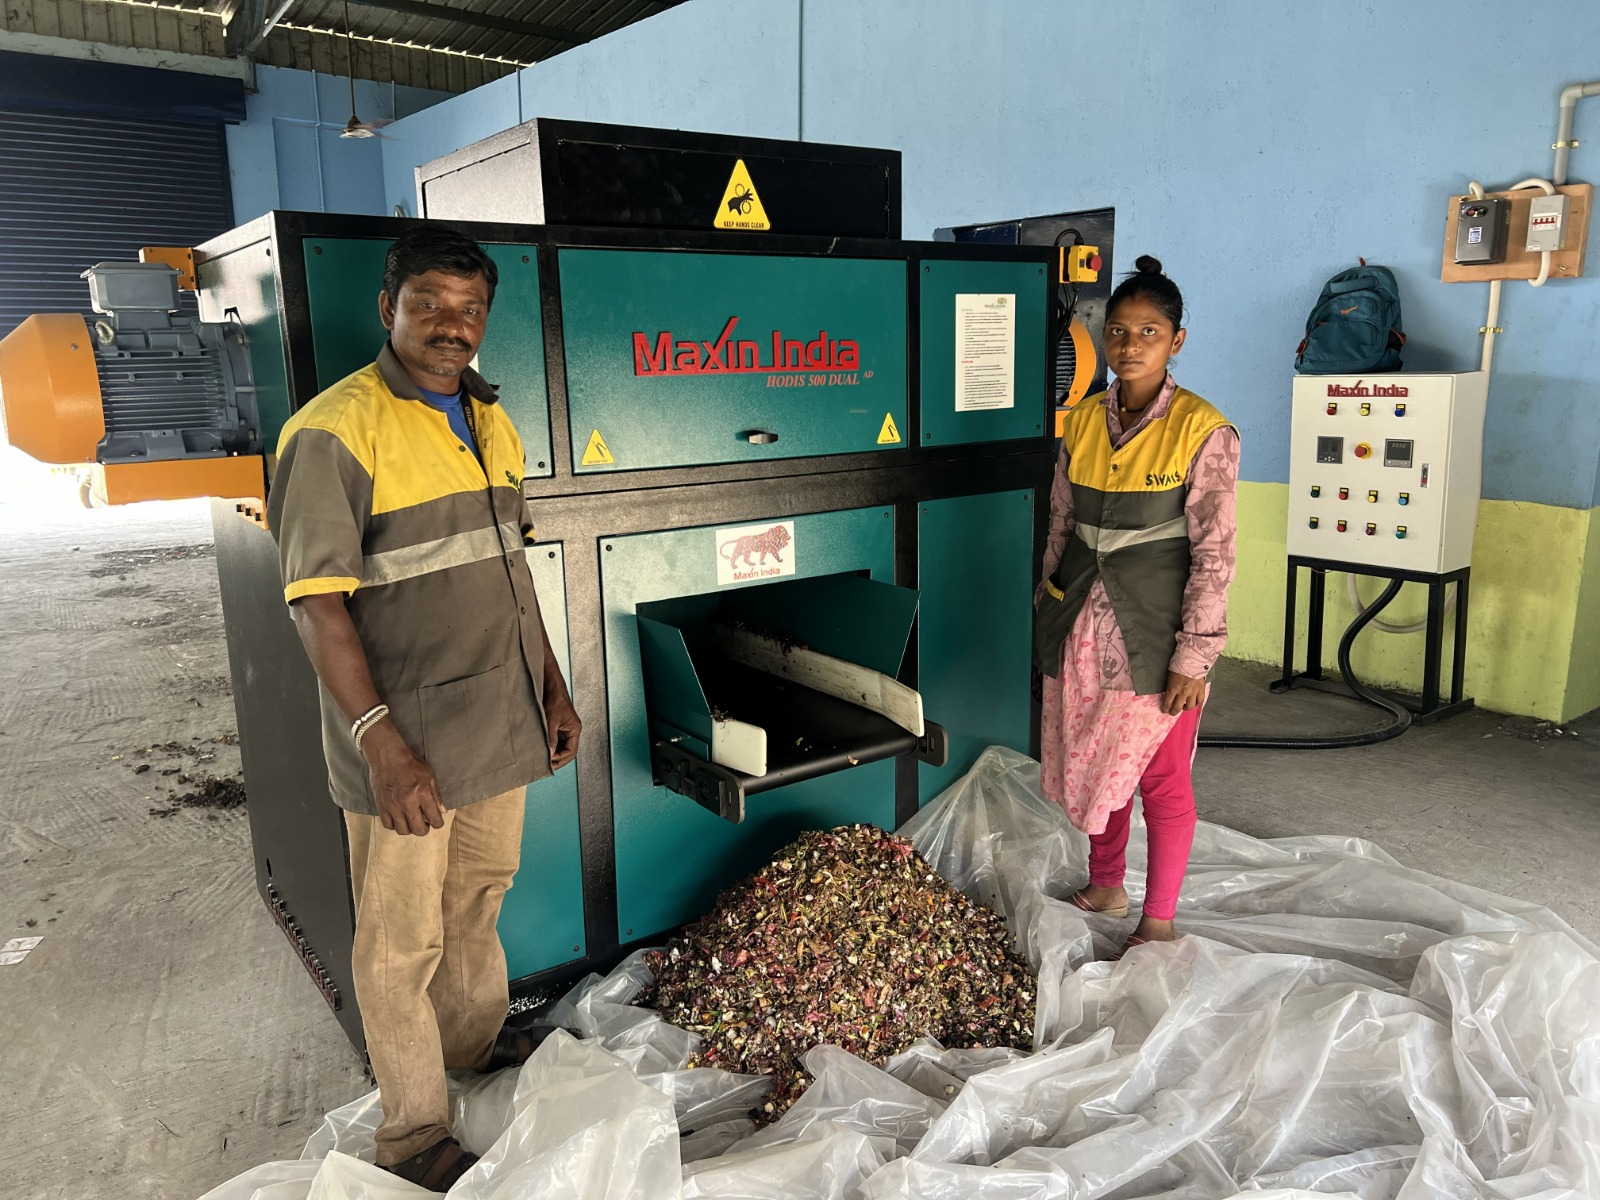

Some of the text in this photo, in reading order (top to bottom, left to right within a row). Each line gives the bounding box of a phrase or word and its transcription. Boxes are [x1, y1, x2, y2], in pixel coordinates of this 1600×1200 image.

[632, 316, 860, 377] Maxin India
[766, 370, 874, 388] HODIS 500 DUAL AD
[1327, 380, 1408, 397] Maxin India
[733, 567, 781, 580] Maxin India
